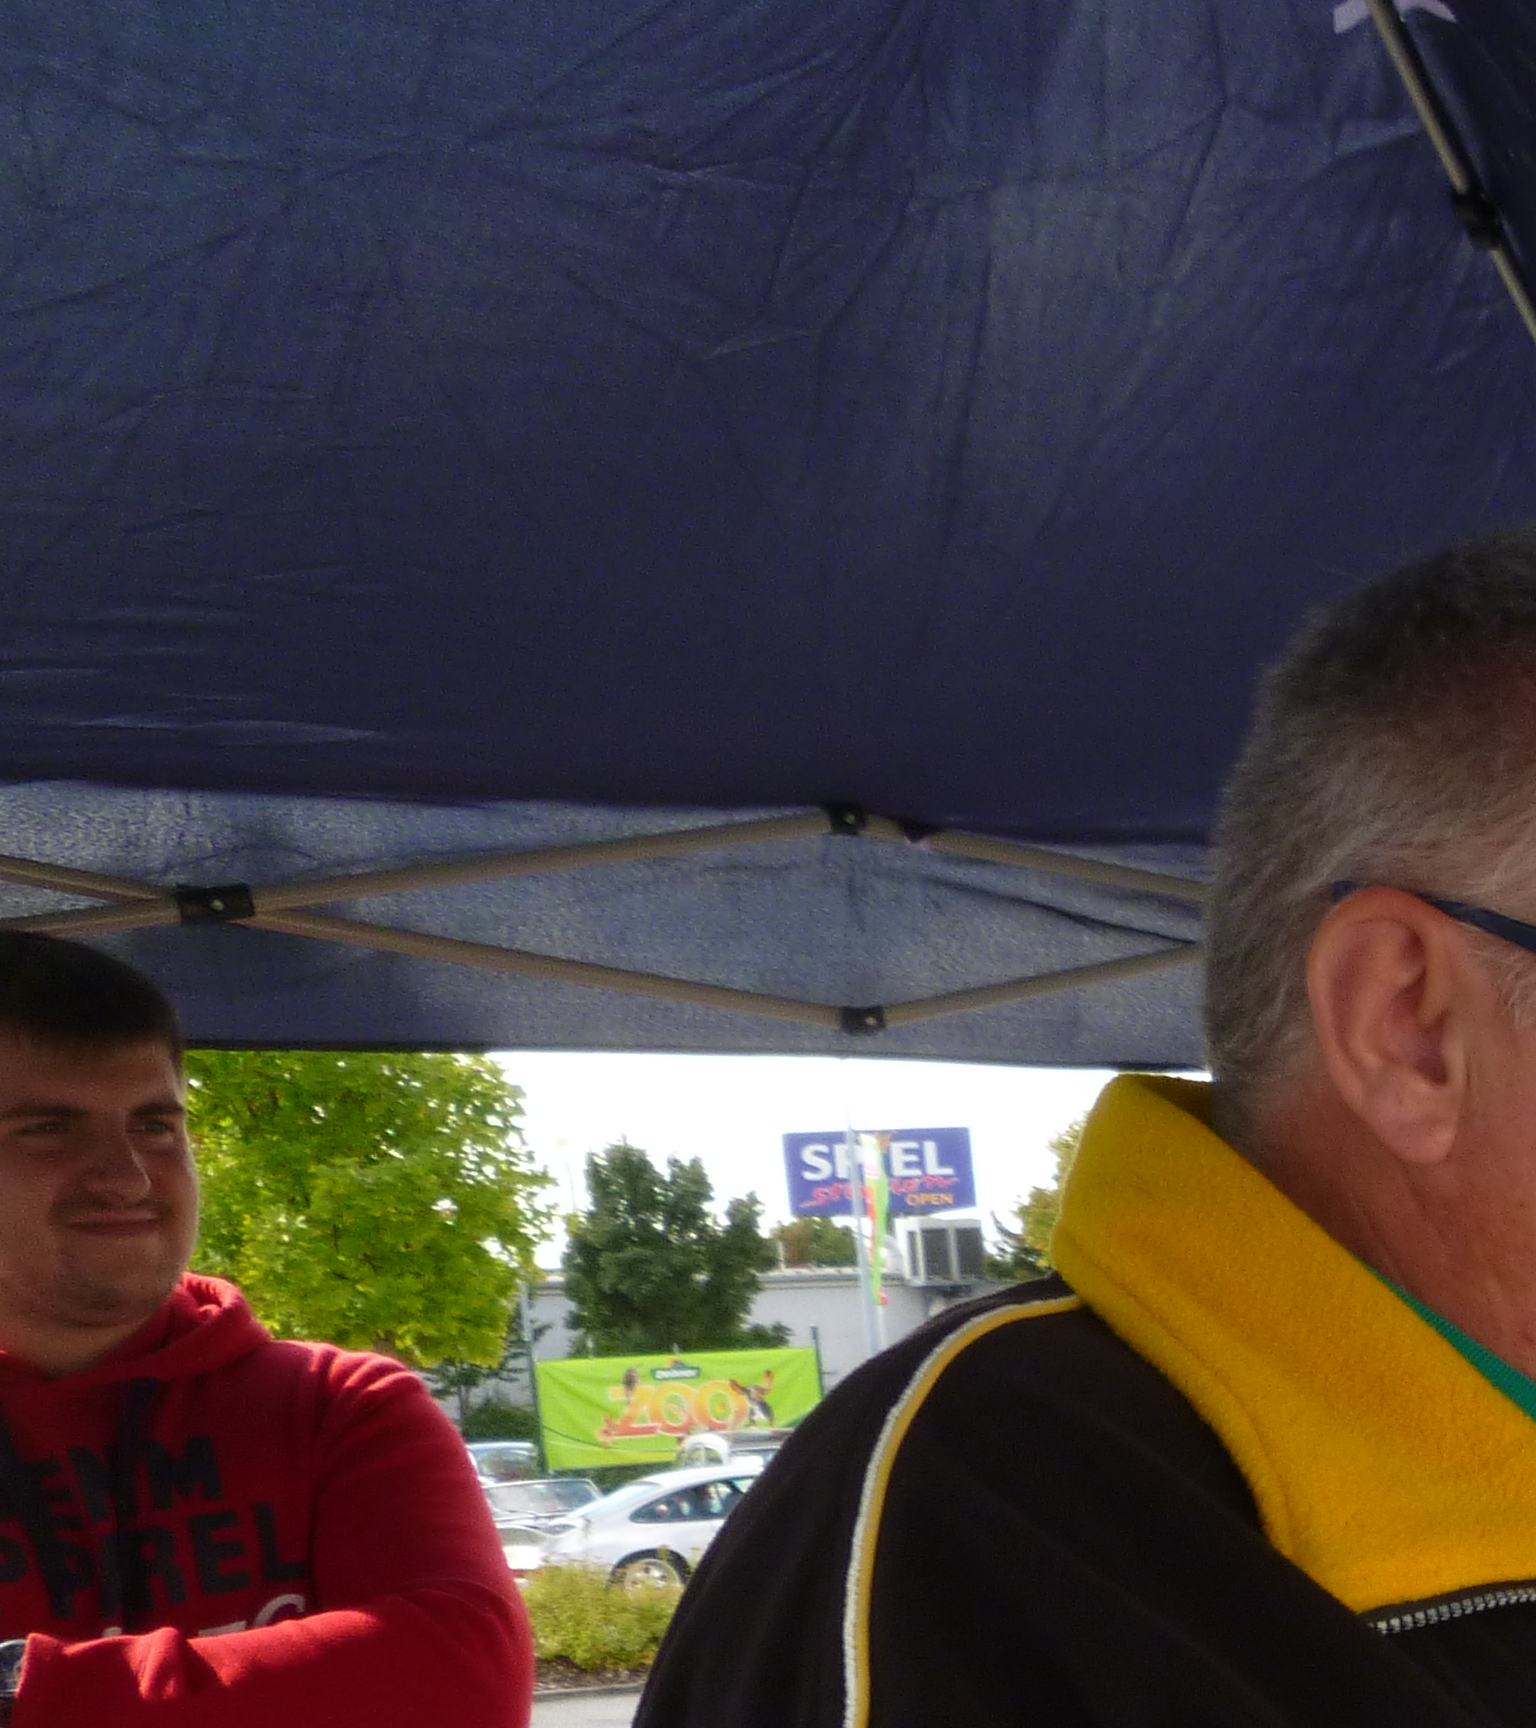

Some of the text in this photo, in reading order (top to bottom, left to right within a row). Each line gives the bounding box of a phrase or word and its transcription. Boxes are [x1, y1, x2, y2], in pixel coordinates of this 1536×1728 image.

[800, 1140, 956, 1182] SPEL
[905, 1192, 955, 1206] OPEN
[604, 1379, 750, 1437] ZOO
